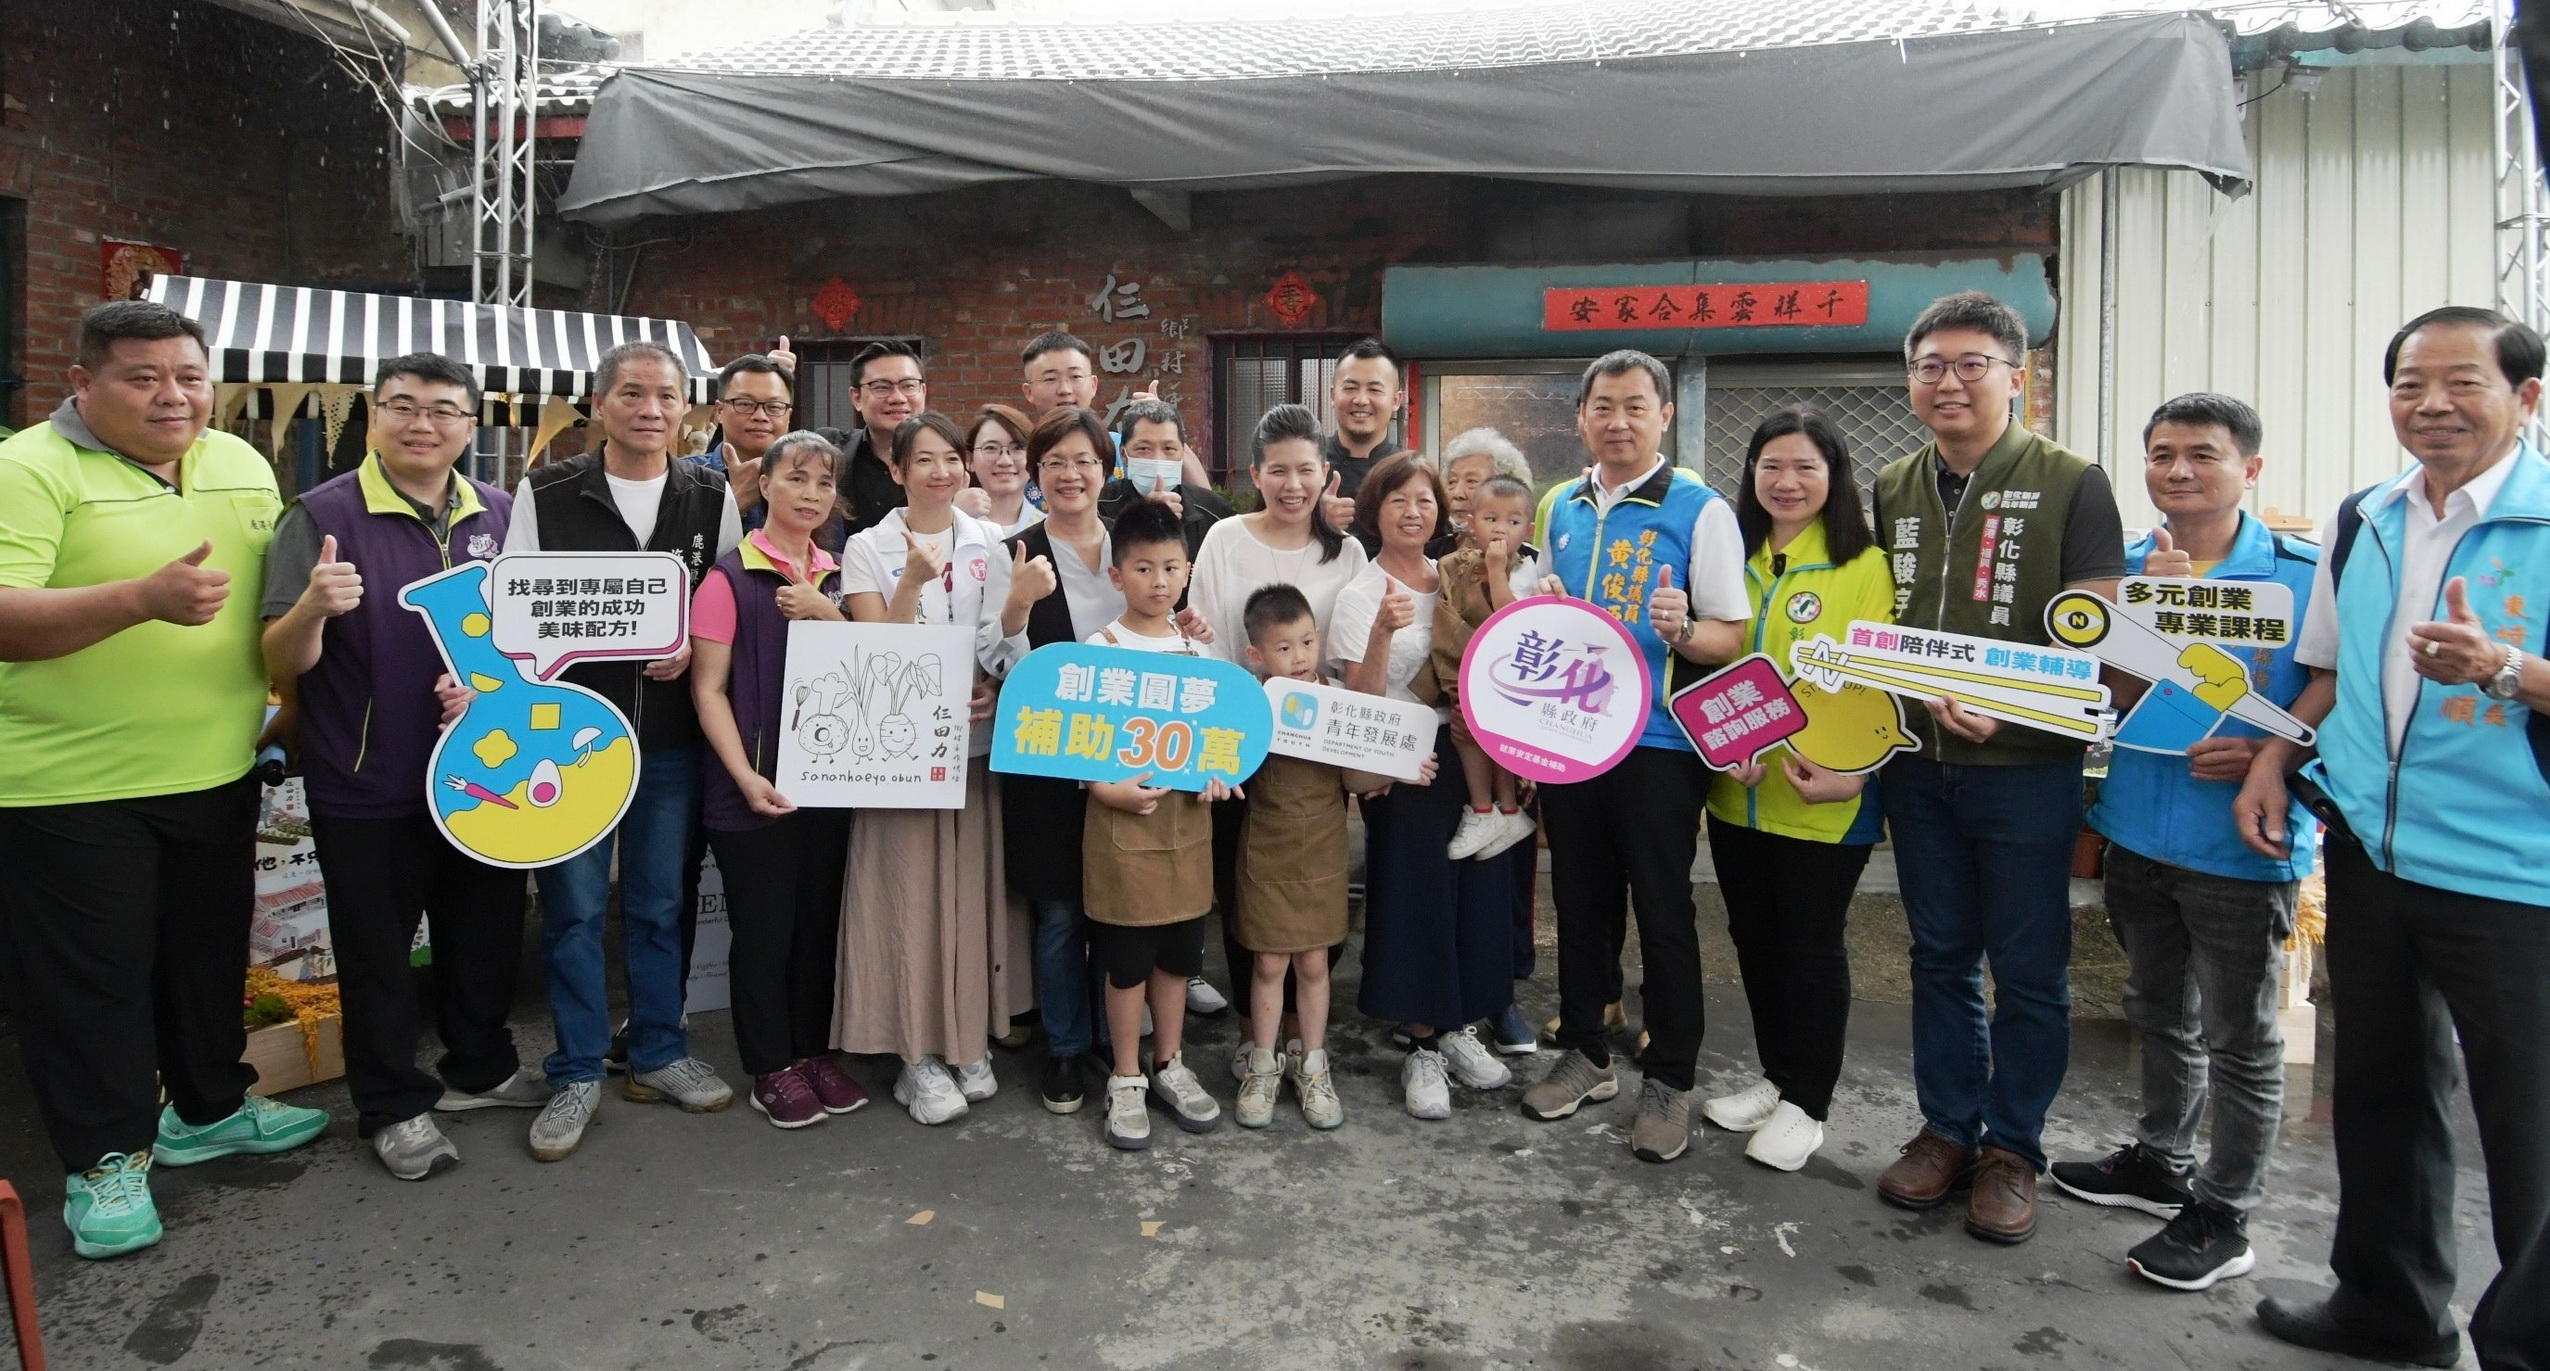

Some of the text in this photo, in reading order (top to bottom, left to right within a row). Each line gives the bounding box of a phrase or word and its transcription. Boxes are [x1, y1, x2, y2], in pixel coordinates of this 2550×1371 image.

[1623, 528, 1658, 624] 彰化縣議員
[1988, 516, 2025, 627] 彰化縣議員
[508, 577, 668, 597] 找尋到專屬自己
[2125, 581, 2252, 611] 多元創業
[530, 599, 646, 618] 創業的成功
[2072, 615, 2086, 628] N
[537, 620, 638, 640] 美味配方!
[2154, 611, 2286, 642] 專業課程
[1851, 627, 2093, 681] 首創陪伴式 創業輔導
[1510, 630, 1606, 714] 彰化
[1054, 662, 1219, 714] 創業圓夢
[1700, 680, 1764, 725] 創業
[1330, 700, 1402, 727] 彰化縣政府
[1540, 702, 1598, 732] 縣政府
[1702, 697, 1792, 752] 諮詢服務
[1013, 705, 1246, 775] 補助30萬
[1277, 730, 1312, 741] CHANGHUA
[1326, 718, 1418, 752] 青年發展處
[1539, 718, 1592, 741] CHANGHUA
[1322, 746, 1366, 760] DEVELOPMENT
[1323, 739, 1363, 751] DEPARTMENT
[1373, 748, 1395, 758] YOUTH
[1499, 743, 1567, 773] 就業安定基金補助
